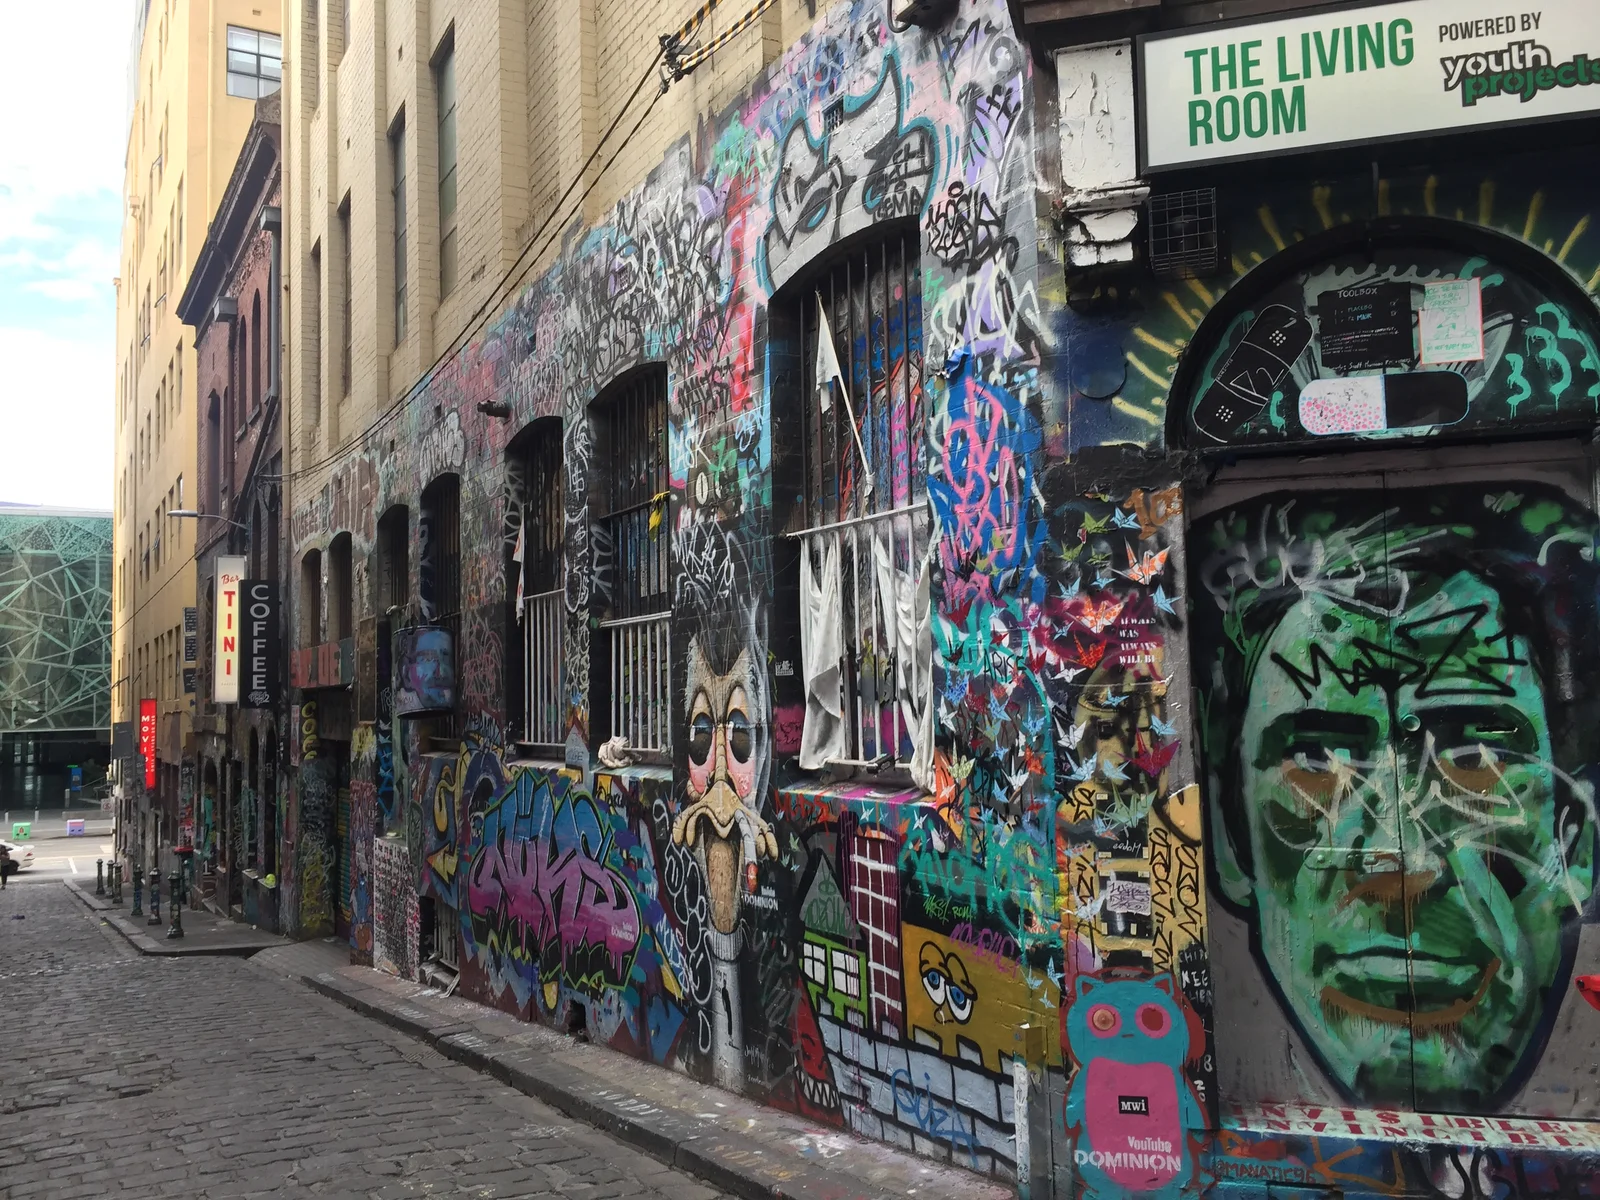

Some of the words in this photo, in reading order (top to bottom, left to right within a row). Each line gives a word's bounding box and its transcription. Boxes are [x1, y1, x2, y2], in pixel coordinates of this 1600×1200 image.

[1439, 15, 1516, 42] POWERED
[1521, 11, 1542, 32] BY
[1184, 39, 1264, 95] THE
[1277, 18, 1415, 83] LIVING
[1440, 39, 1551, 91] youth
[1188, 84, 1307, 147] ROOM
[1338, 288, 1378, 298] TOOLBOX
[1347, 304, 1373, 312] PLACEBO
[221, 574, 240, 584] Bar
[1120, 617, 1157, 625] ALWAYS
[223, 591, 236, 676] TINI
[249, 584, 270, 690] COFFEE
[1119, 629, 1139, 638] WAS
[1119, 654, 1143, 664] WILL
[744, 893, 779, 911] DOMINION
[1127, 1135, 1173, 1154] YouTube
[1074, 1149, 1182, 1173] DOMINION
